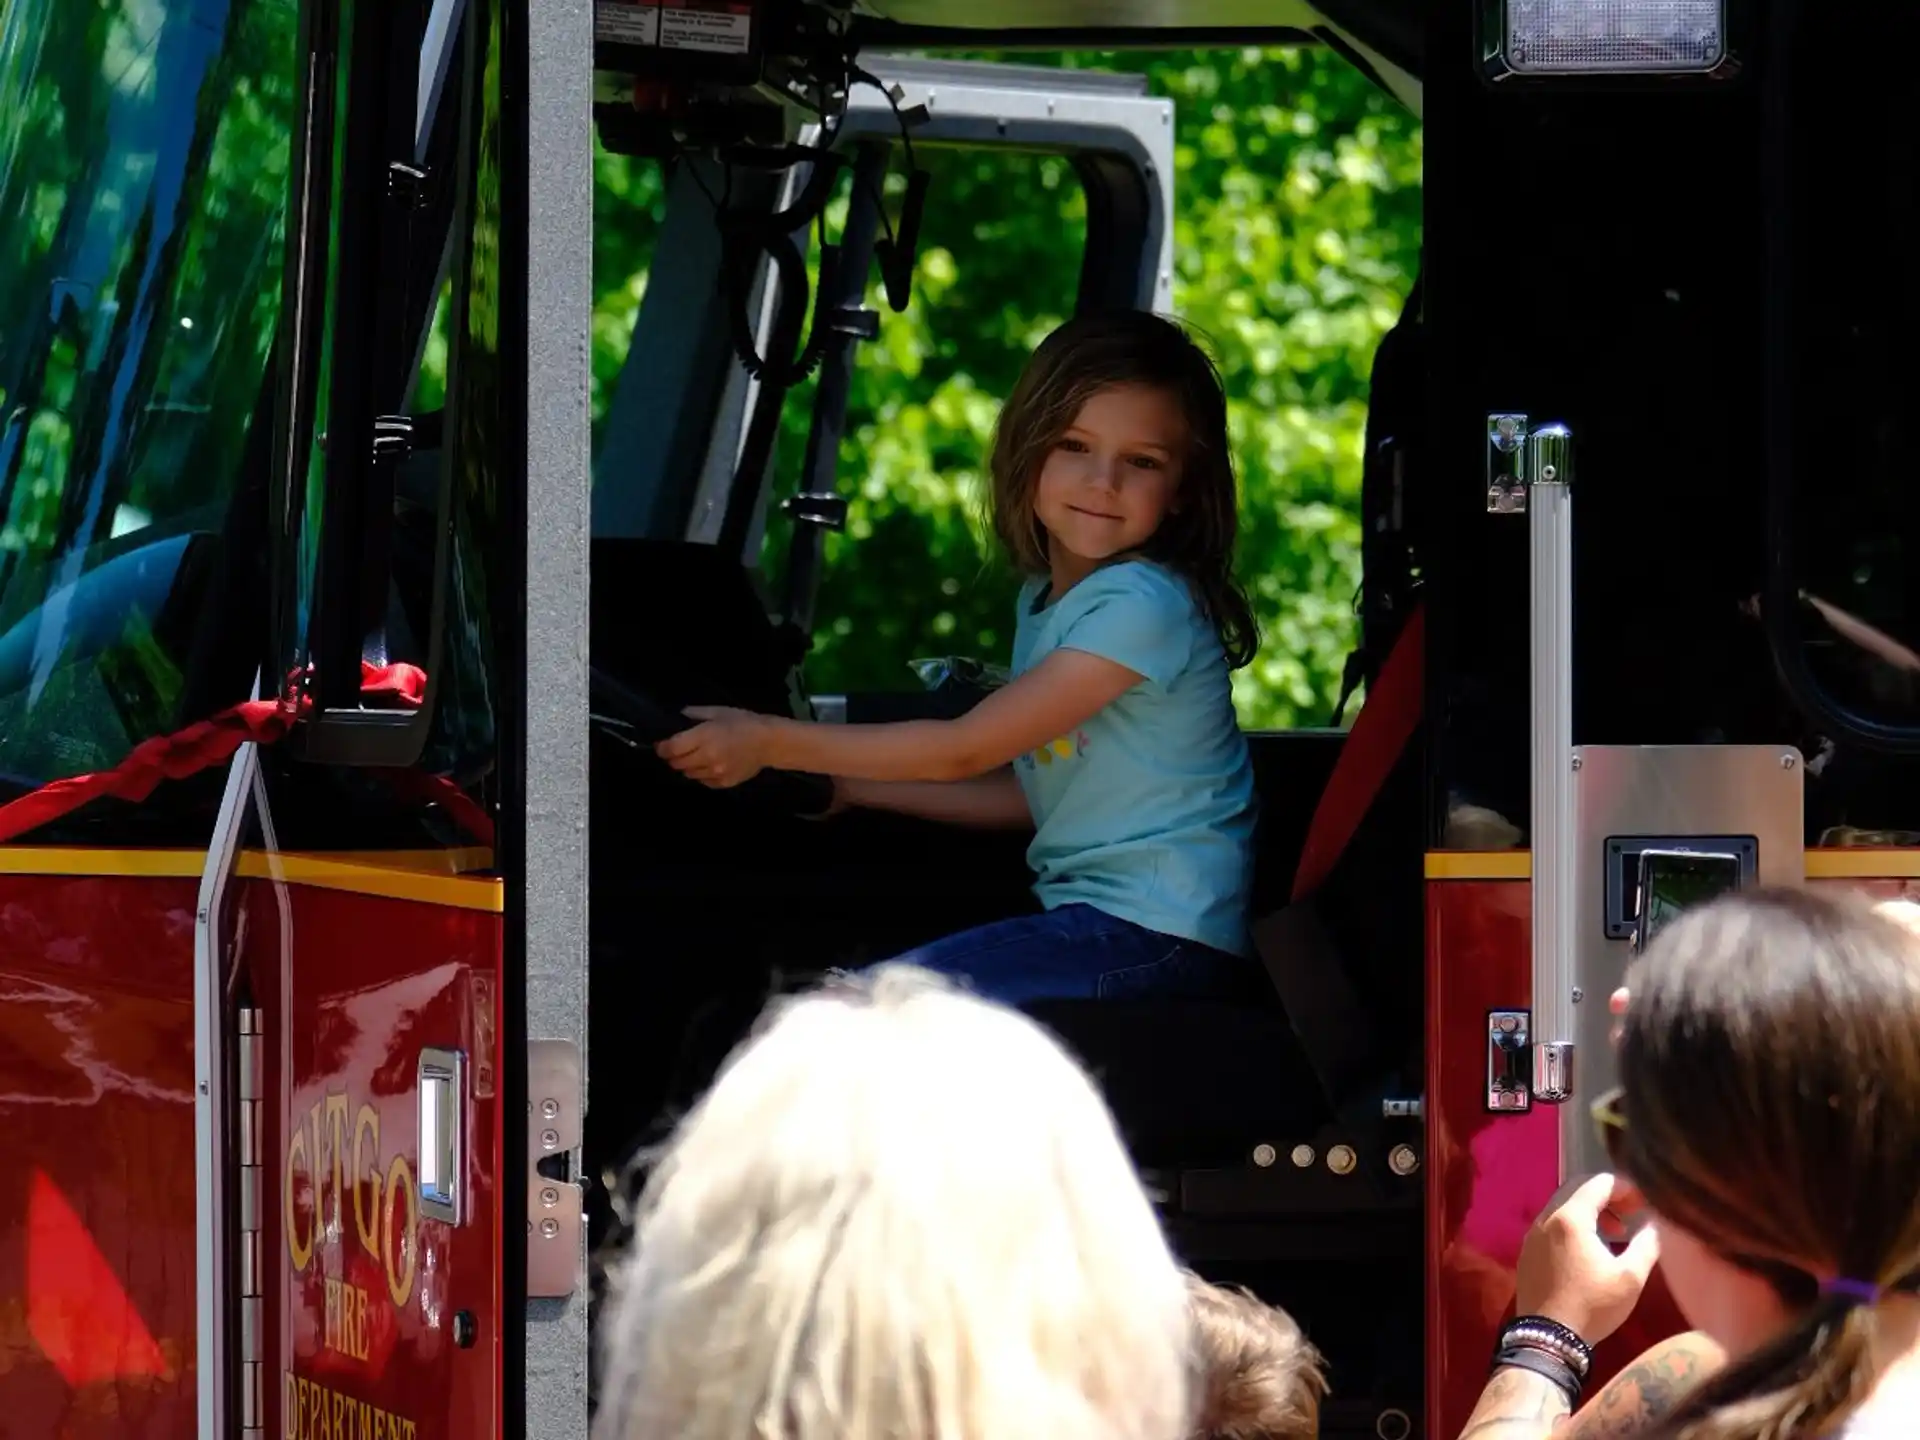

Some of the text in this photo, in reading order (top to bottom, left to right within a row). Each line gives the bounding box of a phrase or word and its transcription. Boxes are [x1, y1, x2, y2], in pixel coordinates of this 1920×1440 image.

[285, 1091, 417, 1308] CITGO
[324, 1277, 369, 1361] FIRE
[285, 1370, 417, 1440] DEPARTM
